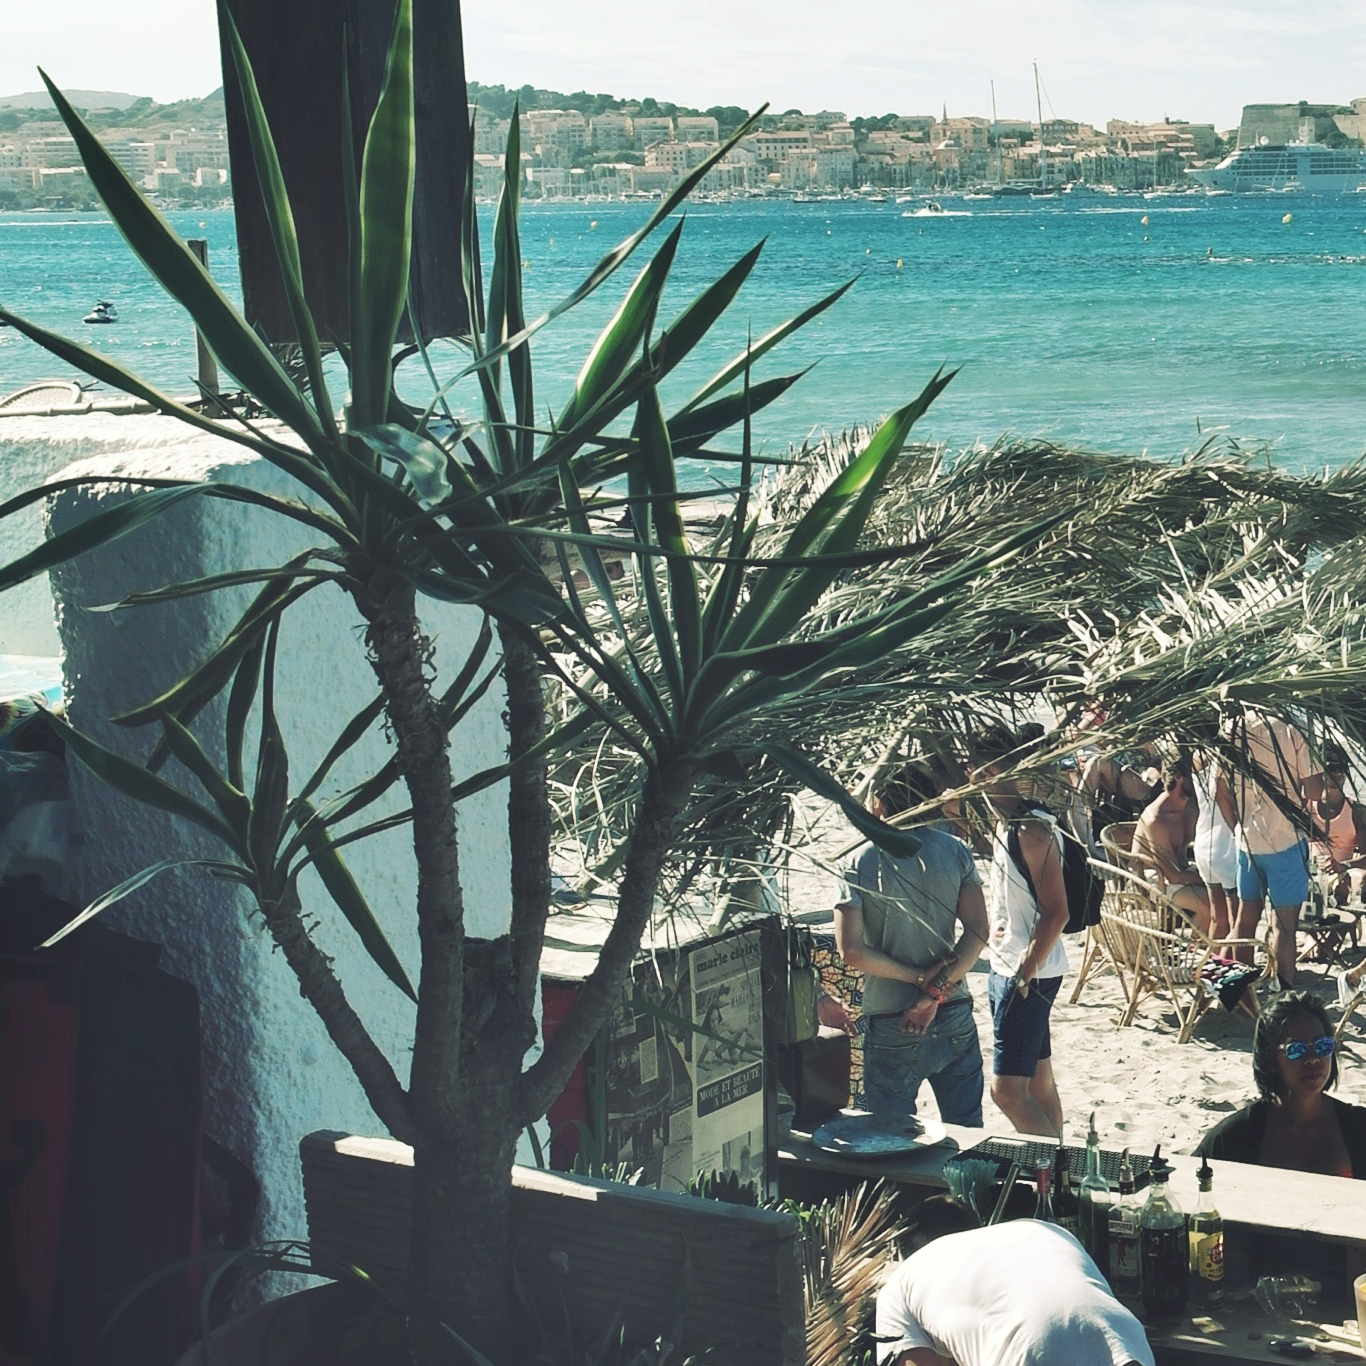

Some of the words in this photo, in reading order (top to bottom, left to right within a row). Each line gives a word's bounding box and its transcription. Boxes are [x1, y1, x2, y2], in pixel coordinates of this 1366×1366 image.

[696, 952, 728, 974] marie
[729, 942, 760, 961] claire
[699, 1084, 720, 1102] MODE
[721, 1079, 731, 1092] ET
[721, 1093, 731, 1104] LA
[733, 1084, 748, 1098] MER
